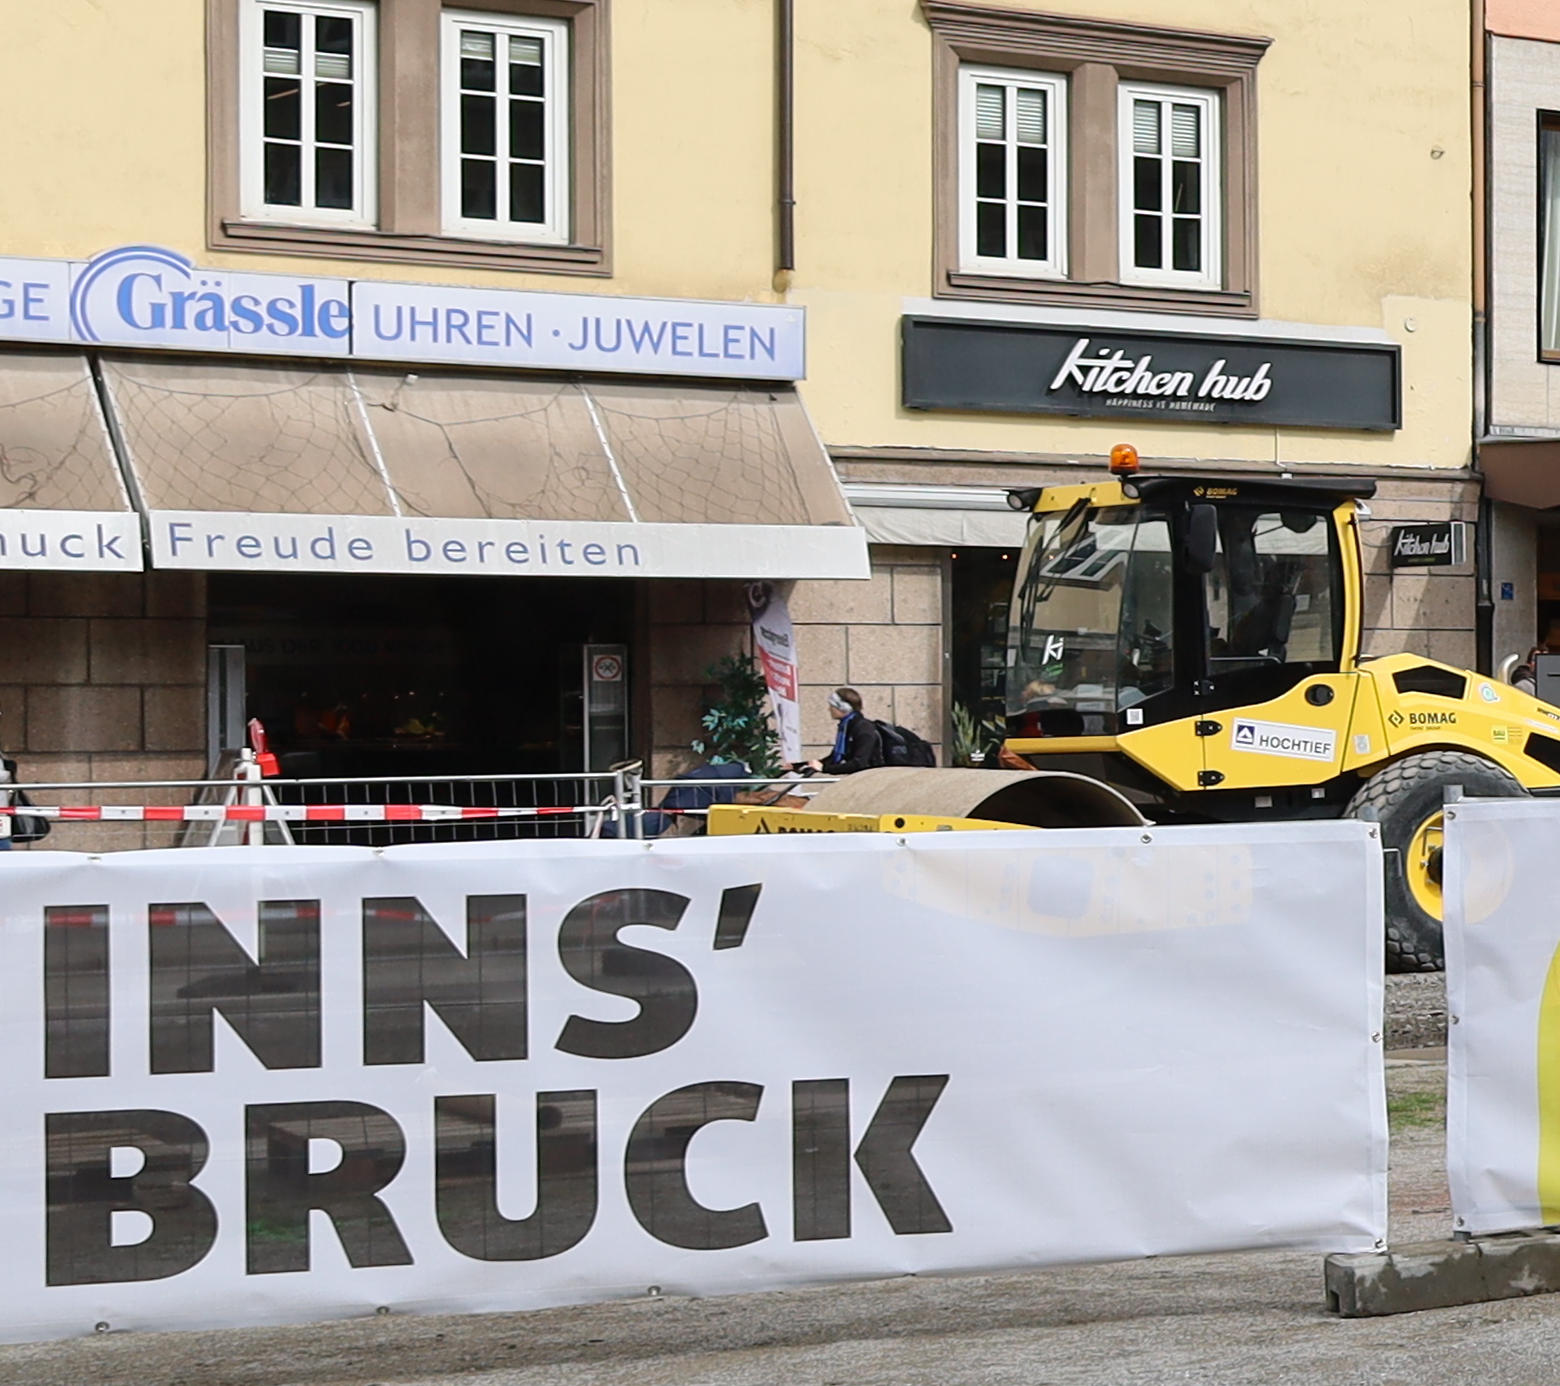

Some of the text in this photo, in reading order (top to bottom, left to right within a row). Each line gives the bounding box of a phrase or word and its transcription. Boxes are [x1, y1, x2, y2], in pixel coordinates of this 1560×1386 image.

[115, 271, 354, 340] Grässle
[372, 303, 778, 363] UHREN JUWELEN
[1197, 358, 1273, 402] hub
[167, 522, 642, 567] Freude bereiten
[1409, 712, 1457, 725] BOMAG
[1259, 734, 1332, 756] HOCHTIEF
[43, 1073, 955, 1288] BRUCK
